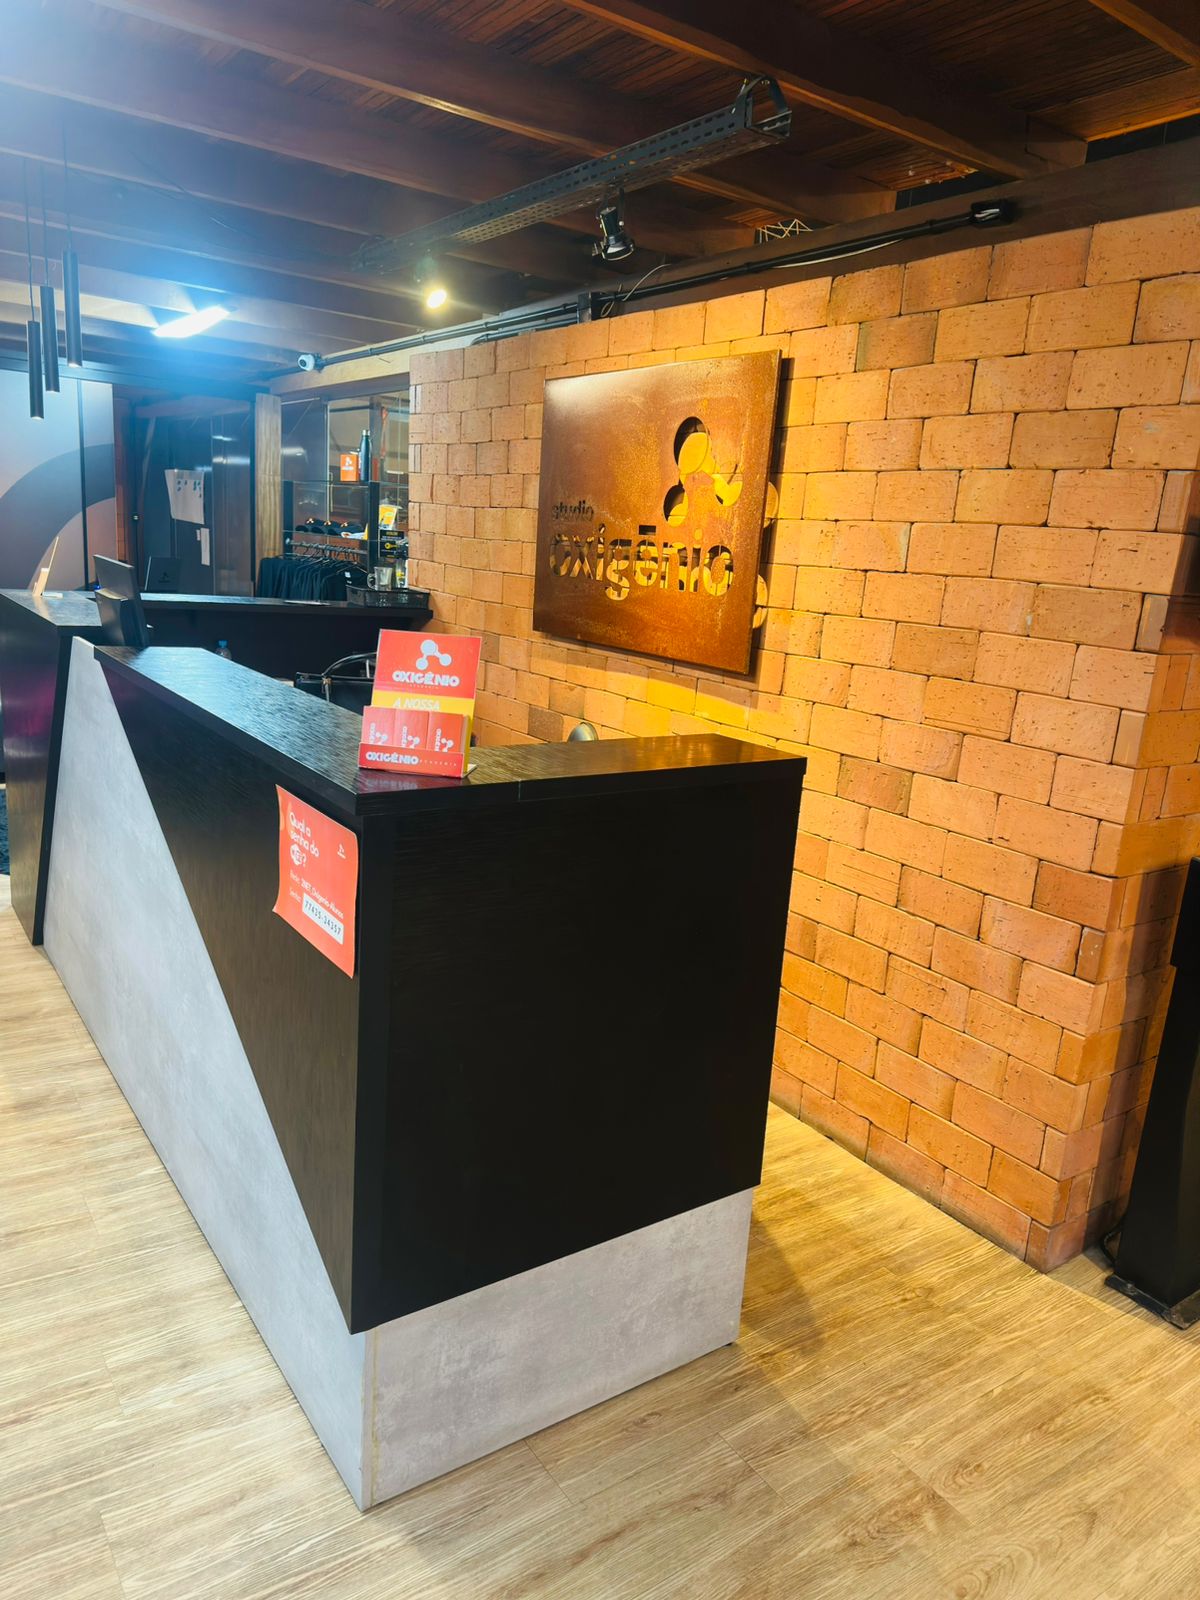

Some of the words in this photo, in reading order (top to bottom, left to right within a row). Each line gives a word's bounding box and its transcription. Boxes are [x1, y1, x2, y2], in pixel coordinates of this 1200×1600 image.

[552, 500, 594, 521] studio
[392, 670, 460, 687] OXIGÊNIO
[393, 697, 401, 709] A
[404, 698, 440, 710] NOSSA
[365, 751, 419, 765] OXIGÊNIO
[289, 812, 305, 834] Qual
[305, 826, 312, 838] a
[289, 831, 309, 850] senha
[310, 840, 319, 857] do
